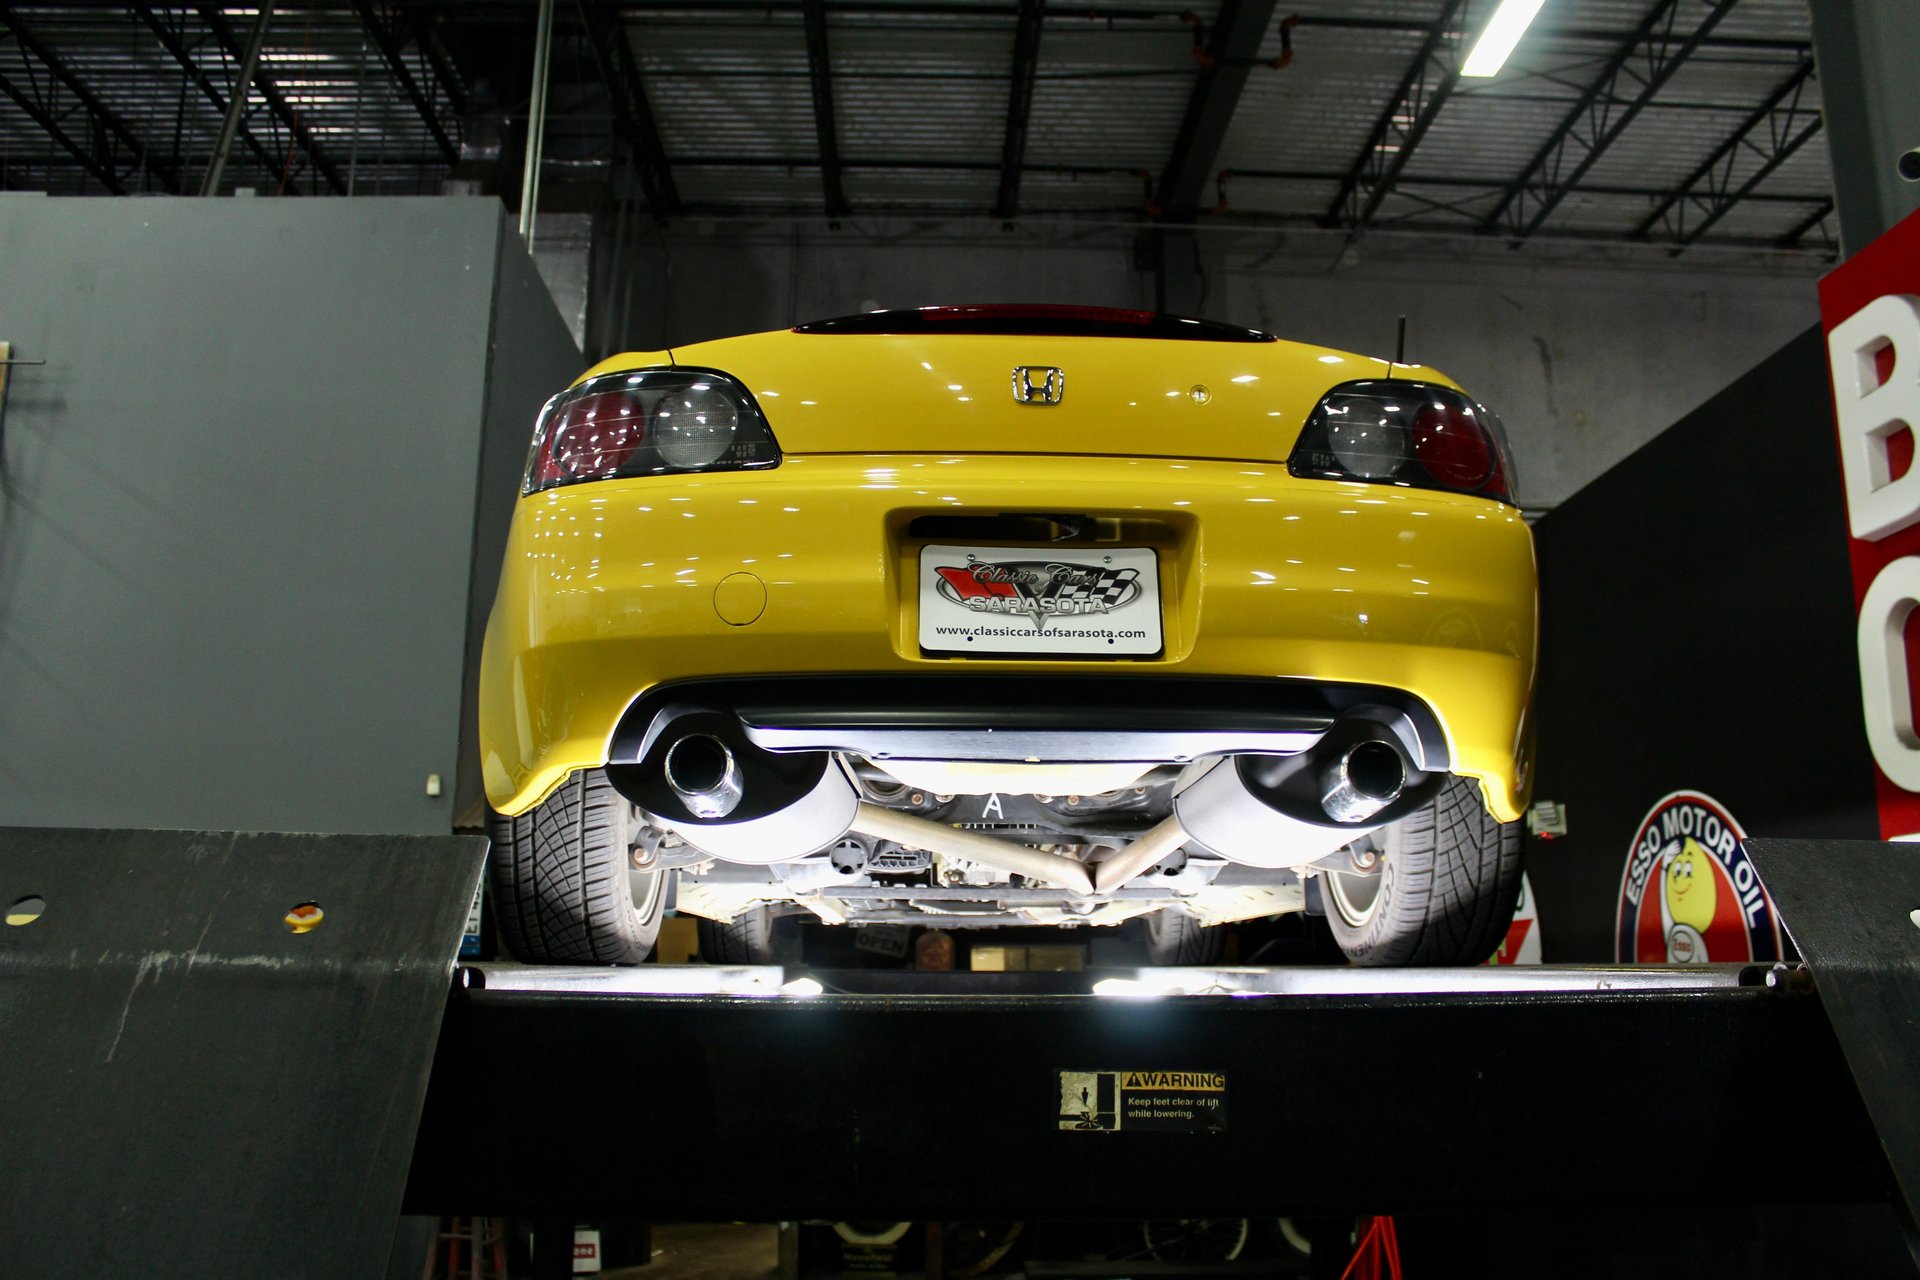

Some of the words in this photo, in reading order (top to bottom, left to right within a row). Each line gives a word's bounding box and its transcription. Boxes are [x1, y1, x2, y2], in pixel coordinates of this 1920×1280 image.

[968, 561, 1039, 585] Classic
[1045, 563, 1102, 586] Cars
[969, 596, 1109, 615] SARASOTA
[936, 625, 1146, 639] www.classiccarsofsarasota.com
[1626, 825, 1661, 906] ESSO
[1662, 805, 1736, 866] MOTOR
[1734, 861, 1765, 929] OIL
[858, 934, 904, 954] OPEN
[1143, 1073, 1224, 1089] WARNING
[1128, 1097, 1151, 1107] Keep
[1153, 1097, 1170, 1106] feet
[1172, 1097, 1194, 1106] clear
[1196, 1098, 1205, 1107] of
[1207, 1098, 1219, 1108] lift
[1128, 1109, 1152, 1118] while
[1154, 1109, 1195, 1120] lowering.
